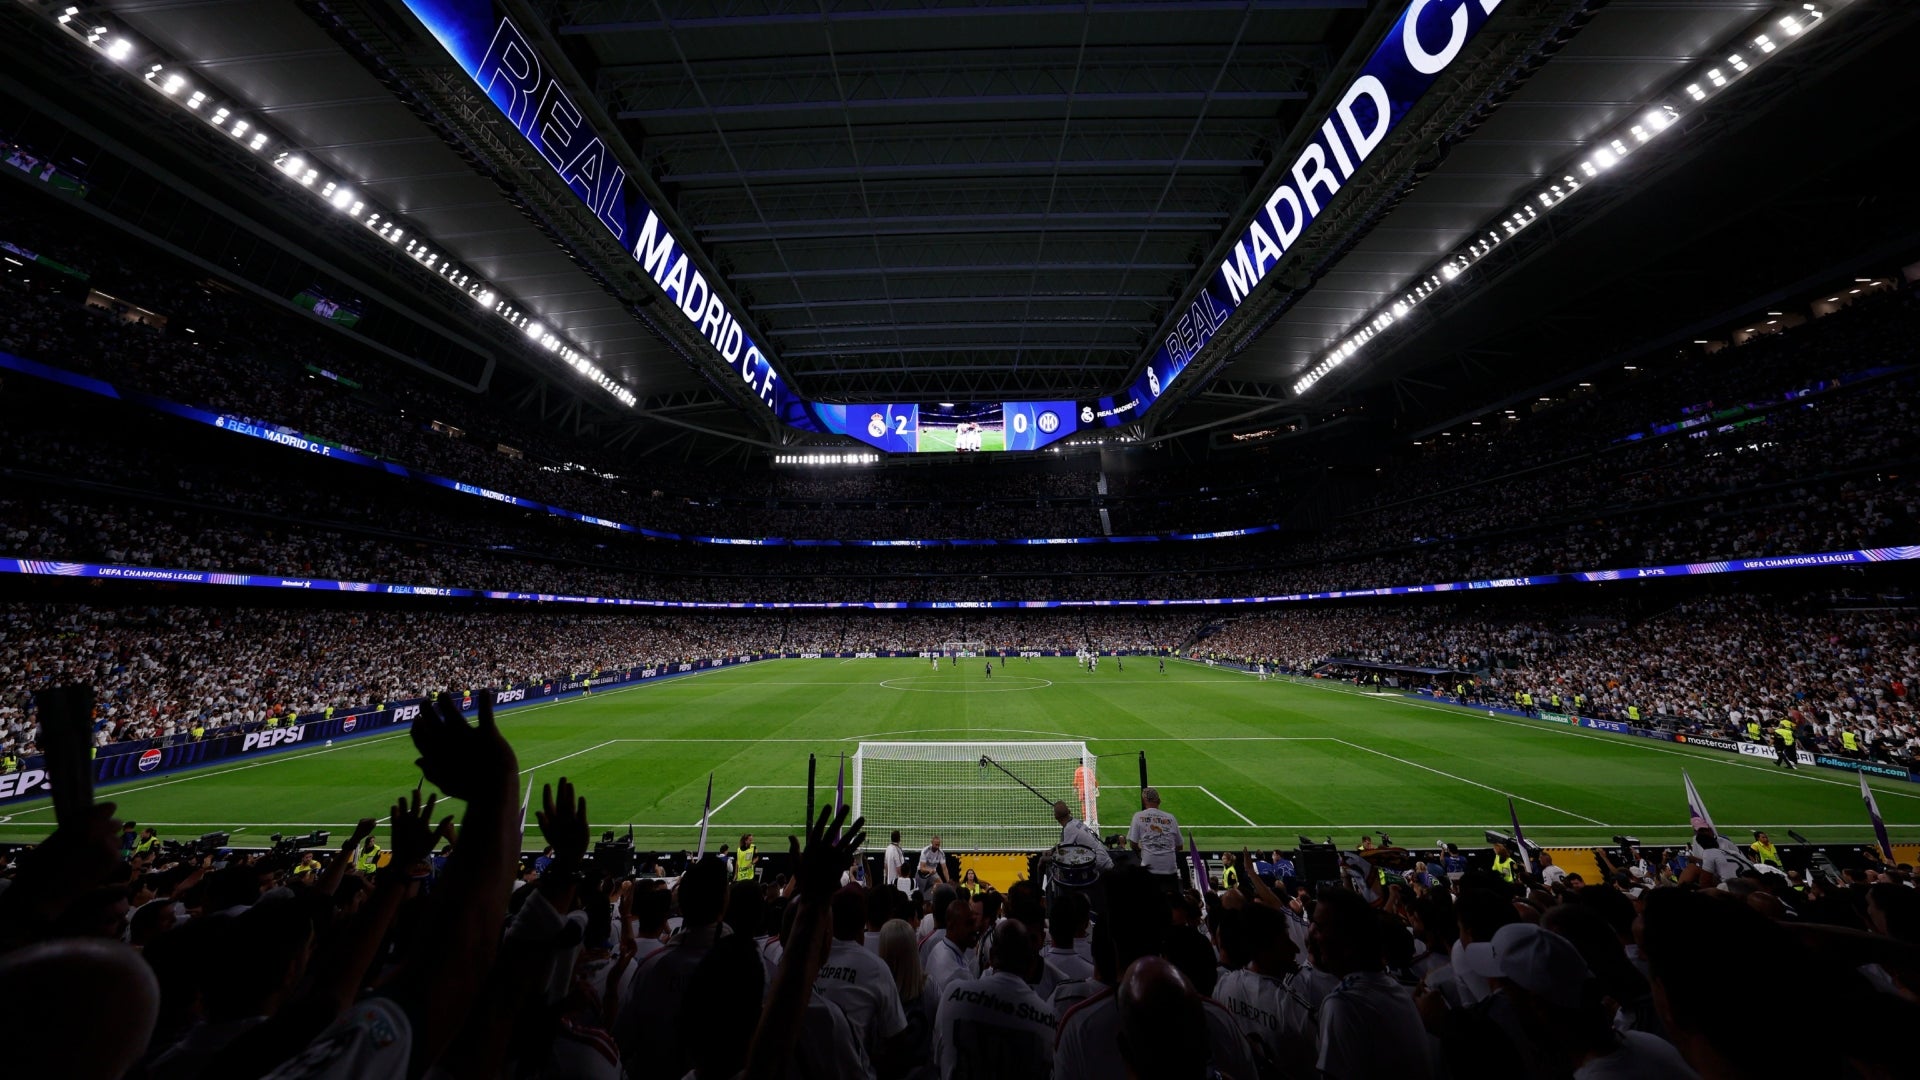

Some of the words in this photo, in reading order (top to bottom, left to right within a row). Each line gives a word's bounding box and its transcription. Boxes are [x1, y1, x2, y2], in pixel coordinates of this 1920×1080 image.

[474, 16, 626, 241] REAL
[632, 209, 742, 364] MADRID
[742, 347, 759, 390] C.
[760, 367, 777, 407] F.
[1165, 287, 1228, 375] REAL
[1220, 74, 1391, 306] MADRID
[1096, 409, 1114, 418] REAL
[894, 415, 908, 435] 2
[1013, 413, 1028, 433] 0
[227, 419, 260, 438] REAL
[263, 429, 308, 450] MADRID
[309, 444, 320, 454] C.
[322, 446, 331, 457] F.
[461, 484, 479, 495] REAL
[480, 488, 505, 502] MADRID
[1743, 560, 1765, 569] UEFA
[1765, 556, 1817, 568] CHAMPIONS
[1817, 553, 1855, 564] LEAGUE
[98, 567, 123, 578] UEFA
[123, 568, 174, 580] CHAMPIONS
[173, 572, 203, 582] LEAGUE
[393, 585, 412, 594] REAL
[413, 586, 438, 596] MADRID
[1489, 578, 1516, 589] MADRID
[641, 668, 657, 678] PEPSI
[496, 688, 526, 704] PEPSI
[393, 704, 422, 723] PEP
[1541, 713, 1569, 724] Heineken
[1598, 722, 1620, 731] PS5
[242, 723, 306, 752] PEPSI
[1687, 736, 1738, 751] mastercard
[140, 756, 160, 765] PEPSI
[949, 987, 1014, 1014] Archive
[1016, 1003, 1057, 1029] Studi
[1228, 996, 1276, 1031] ALBERTO
